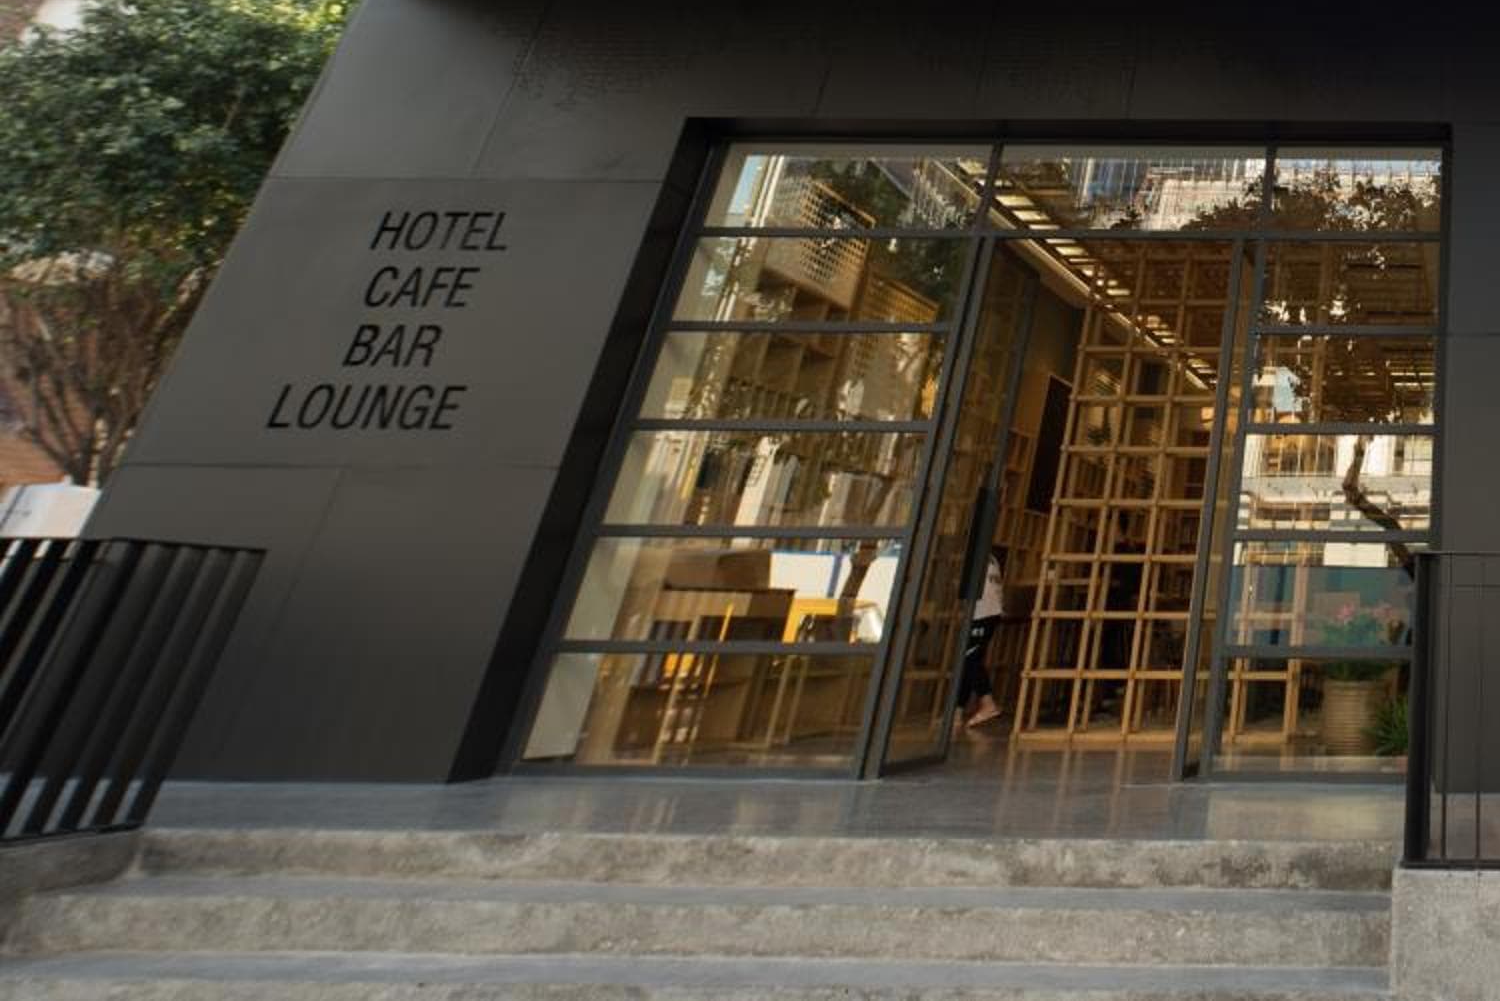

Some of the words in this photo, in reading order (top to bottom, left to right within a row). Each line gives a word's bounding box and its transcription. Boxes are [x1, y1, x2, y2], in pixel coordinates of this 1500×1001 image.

[369, 210, 508, 251] HOTEL
[363, 265, 481, 308] CAFE
[341, 323, 443, 368] BAR
[265, 383, 468, 430] LOUNGE
